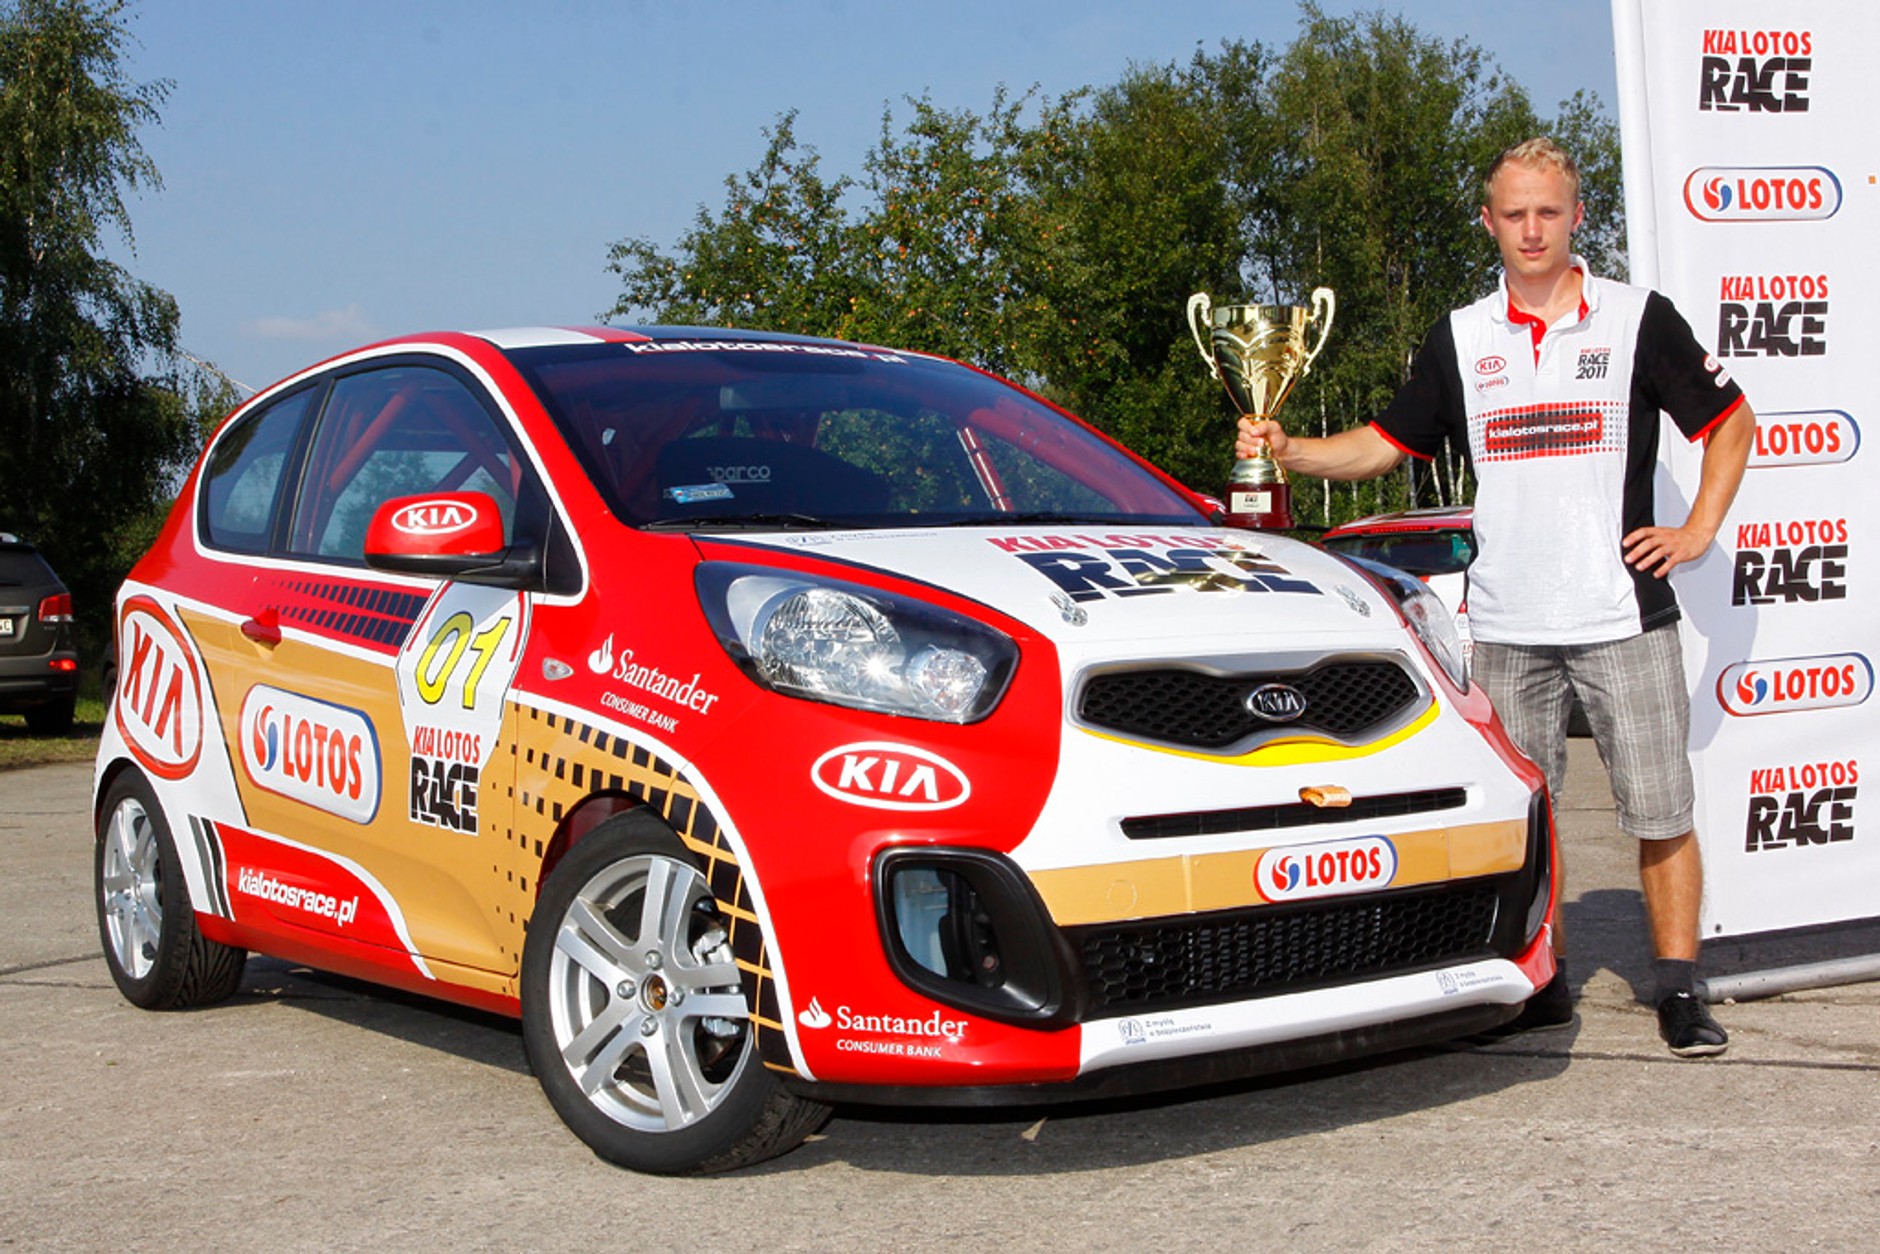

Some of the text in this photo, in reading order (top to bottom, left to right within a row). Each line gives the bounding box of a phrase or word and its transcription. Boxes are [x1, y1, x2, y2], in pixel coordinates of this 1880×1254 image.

[1703, 30, 1811, 55] KIA LOTOS
[1699, 56, 1811, 112] RACE
[1737, 178, 1822, 209] LOTOS
[1721, 275, 1828, 300] KIA LOTOS
[1717, 301, 1828, 357] RACE
[1479, 360, 1501, 371] KIA
[1575, 366, 1608, 380] 2011
[1578, 353, 1610, 366] RACE
[1488, 419, 1598, 439] kialotosrace.pl
[1756, 421, 1840, 456] LOTOS
[406, 507, 463, 528] KIA
[1737, 518, 1848, 548] KIA LOTOS
[986, 536, 1080, 552] KIA
[1014, 548, 1324, 604] RACE
[1732, 545, 1848, 605] RACE
[415, 611, 512, 710] 01
[122, 620, 183, 758] KIA
[612, 649, 719, 715] Santander
[1772, 665, 1855, 701] LOTOS
[600, 692, 680, 733] CONSUMER BANK
[1257, 691, 1299, 711] KIA
[283, 713, 362, 801] LOTOS
[413, 726, 481, 765] KIA LOTOS
[410, 757, 479, 833] RACE
[838, 754, 940, 801] KIA
[1751, 760, 1858, 794] KIA LOTOS
[1745, 787, 1857, 852] RACE
[1306, 846, 1381, 887] LOTOS
[238, 867, 359, 927] kialotosrace.pl
[836, 1005, 968, 1037] Santander
[836, 1039, 942, 1057] CONSUMER BANK
